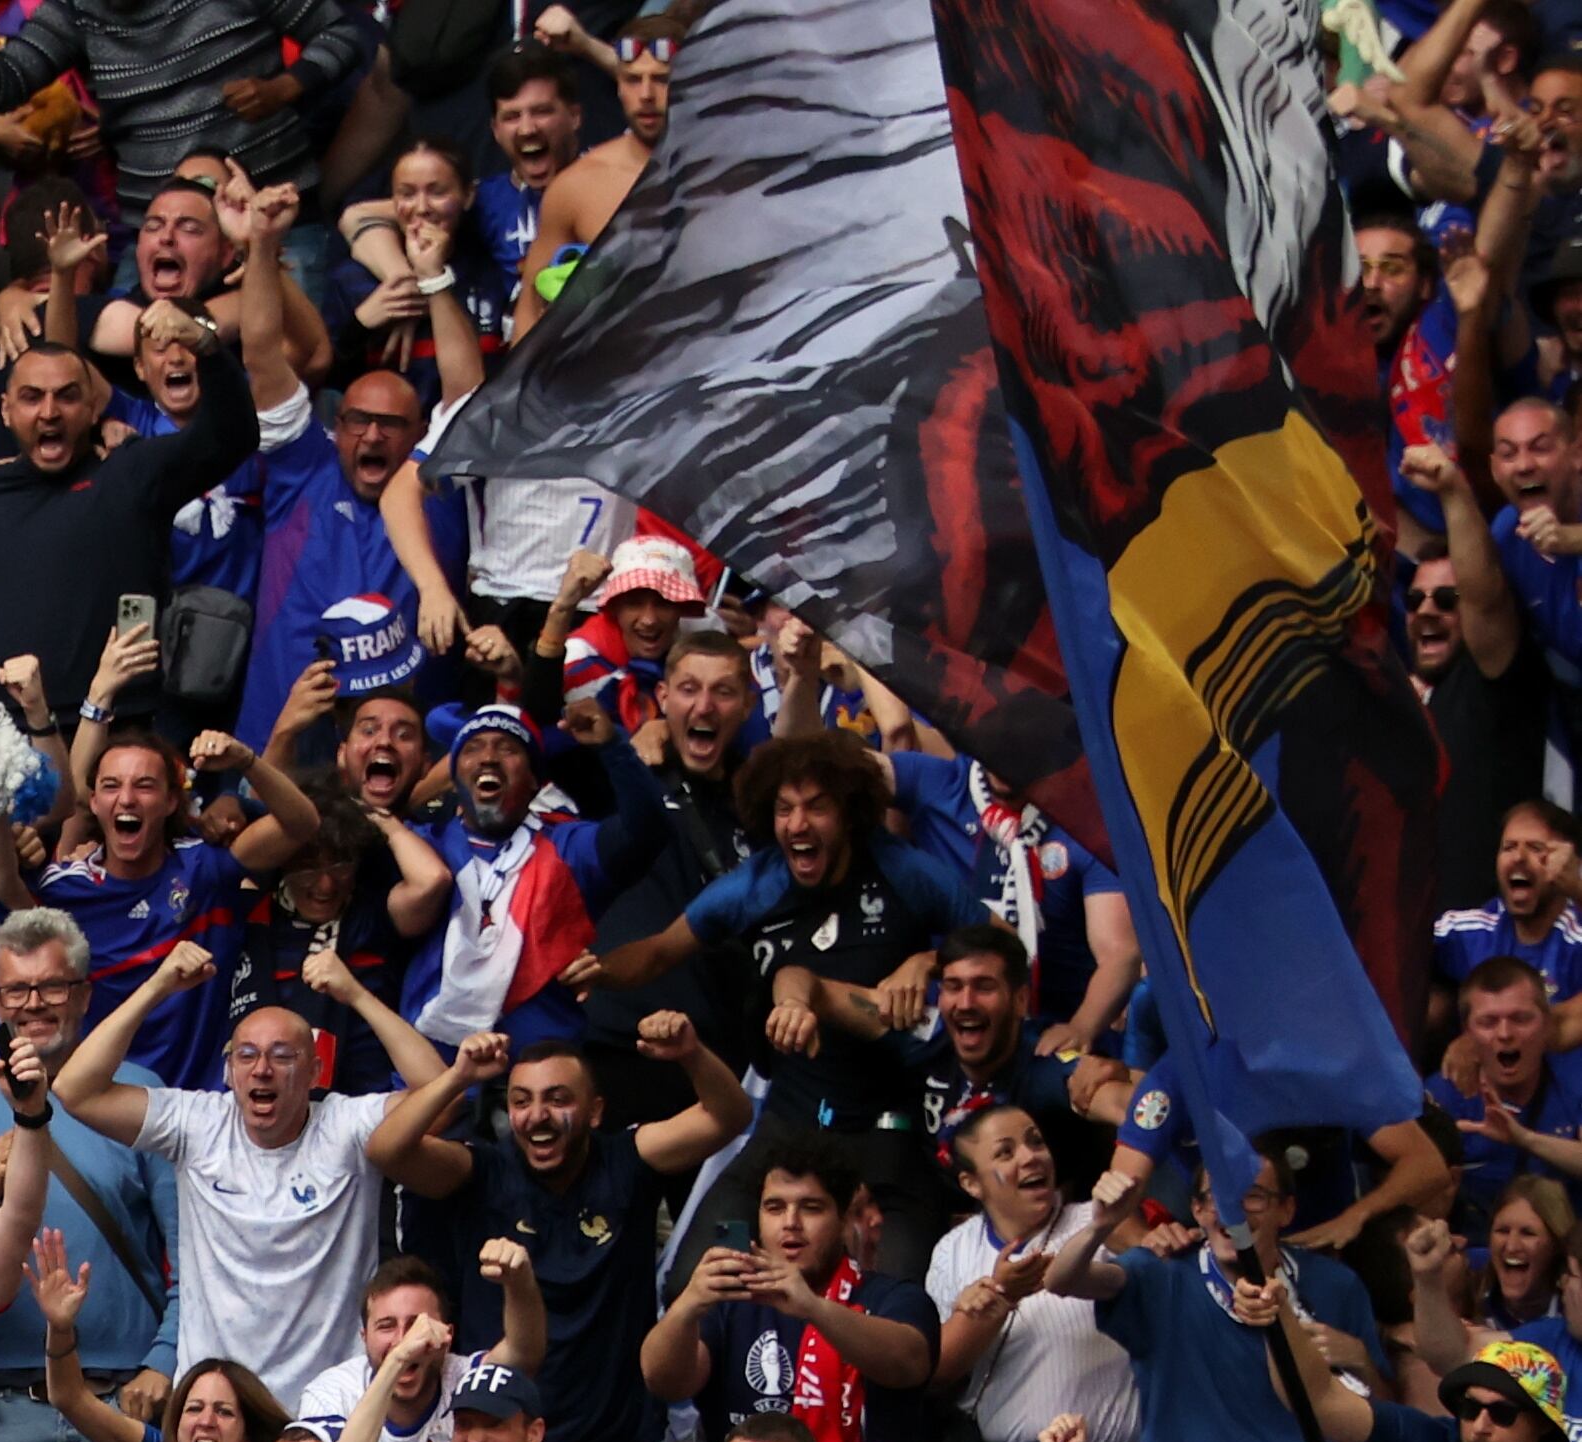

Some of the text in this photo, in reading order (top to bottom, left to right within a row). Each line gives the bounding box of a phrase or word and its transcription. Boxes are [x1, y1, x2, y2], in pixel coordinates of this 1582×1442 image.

[578, 497, 603, 546] 7
[350, 673, 389, 691] ALLEZ
[454, 1364, 514, 1396] FFF
[753, 1397, 792, 1414] UEFA
